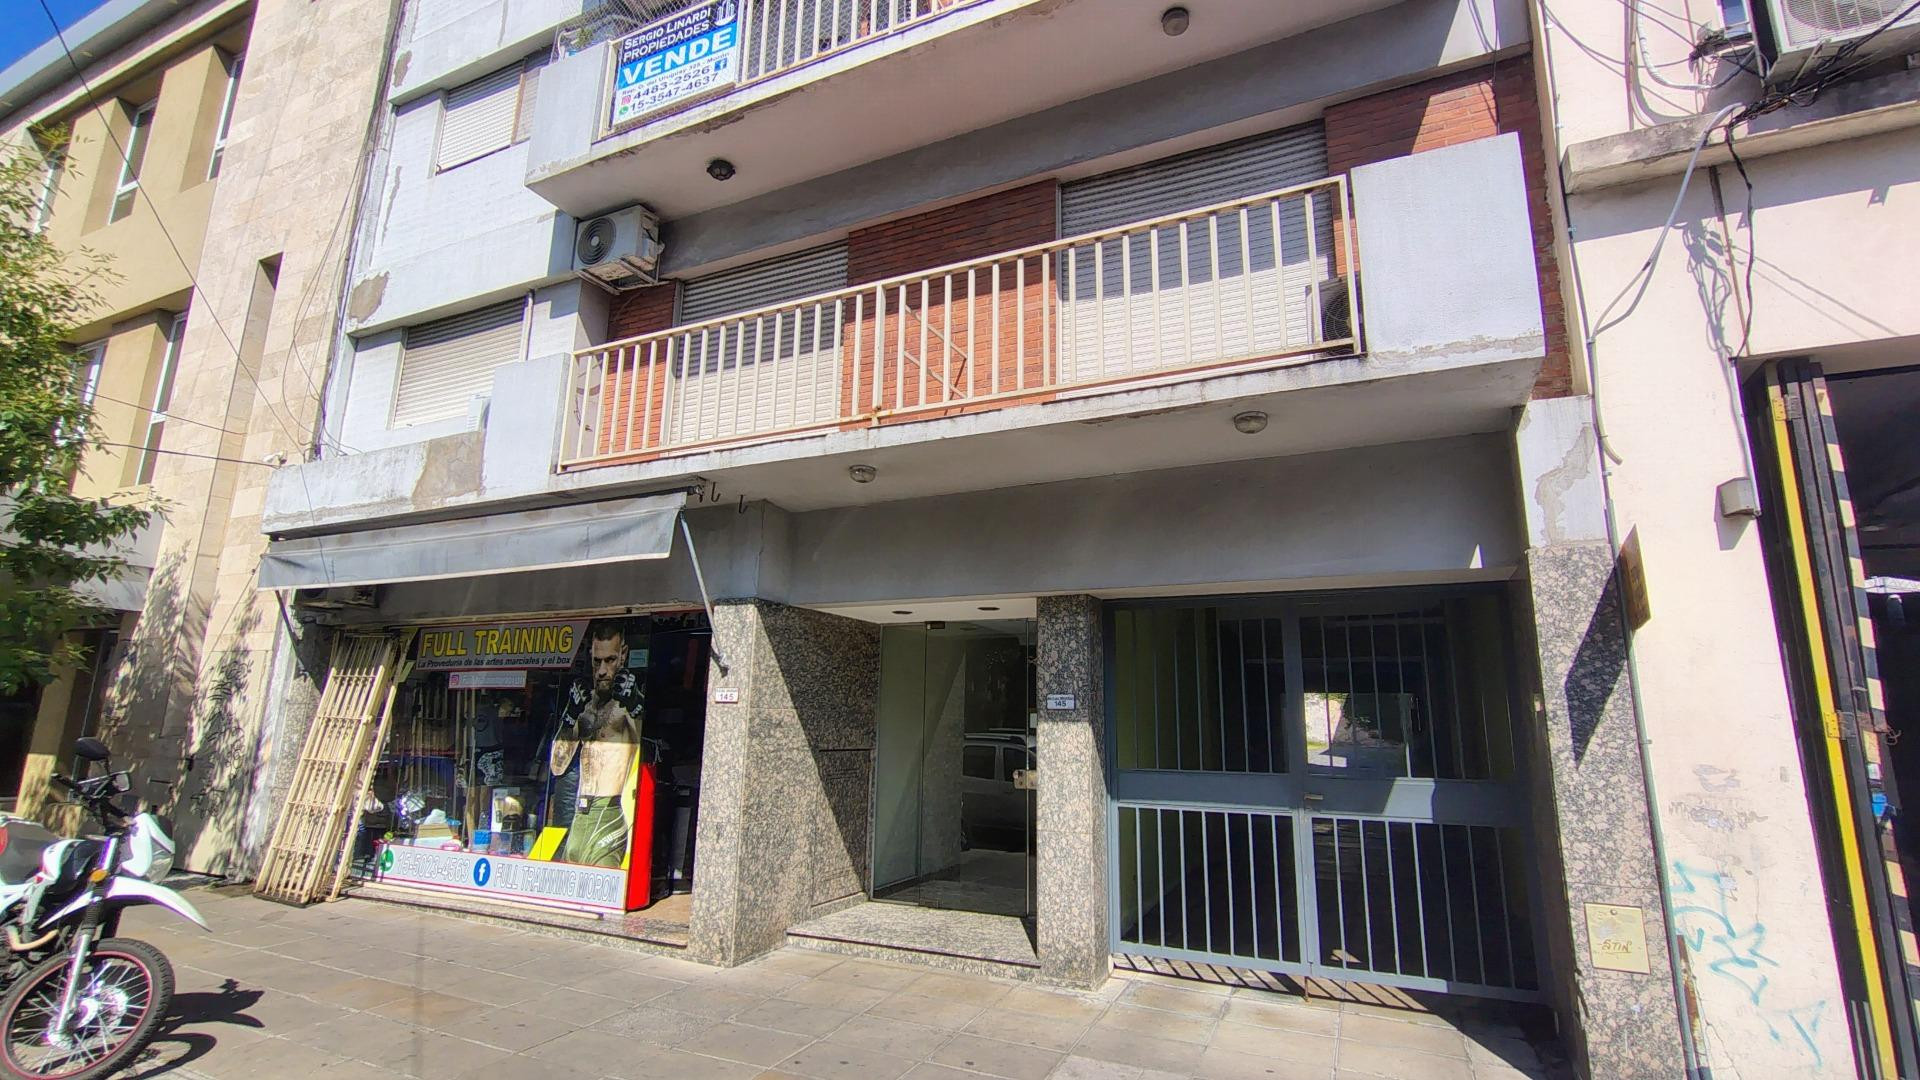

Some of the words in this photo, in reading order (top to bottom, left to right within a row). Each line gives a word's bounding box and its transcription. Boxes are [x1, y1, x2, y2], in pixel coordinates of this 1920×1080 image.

[623, 20, 710, 61] PROPIEDADES
[624, 28, 664, 50] SERGIO
[666, 8, 711, 34] LINARDI
[623, 27, 733, 85] VENDE
[631, 73, 719, 111] 15-3547-4637
[633, 66, 710, 99] 4483-2526
[421, 632, 467, 657] FULL
[475, 625, 575, 655] TRAINING
[473, 658, 484, 666] las
[485, 658, 505, 666] artes
[505, 656, 540, 666] marciales
[540, 658, 546, 667] y
[547, 656, 555, 665] el
[556, 656, 570, 665] box
[494, 863, 519, 890] FULL
[577, 871, 621, 903] MORON
